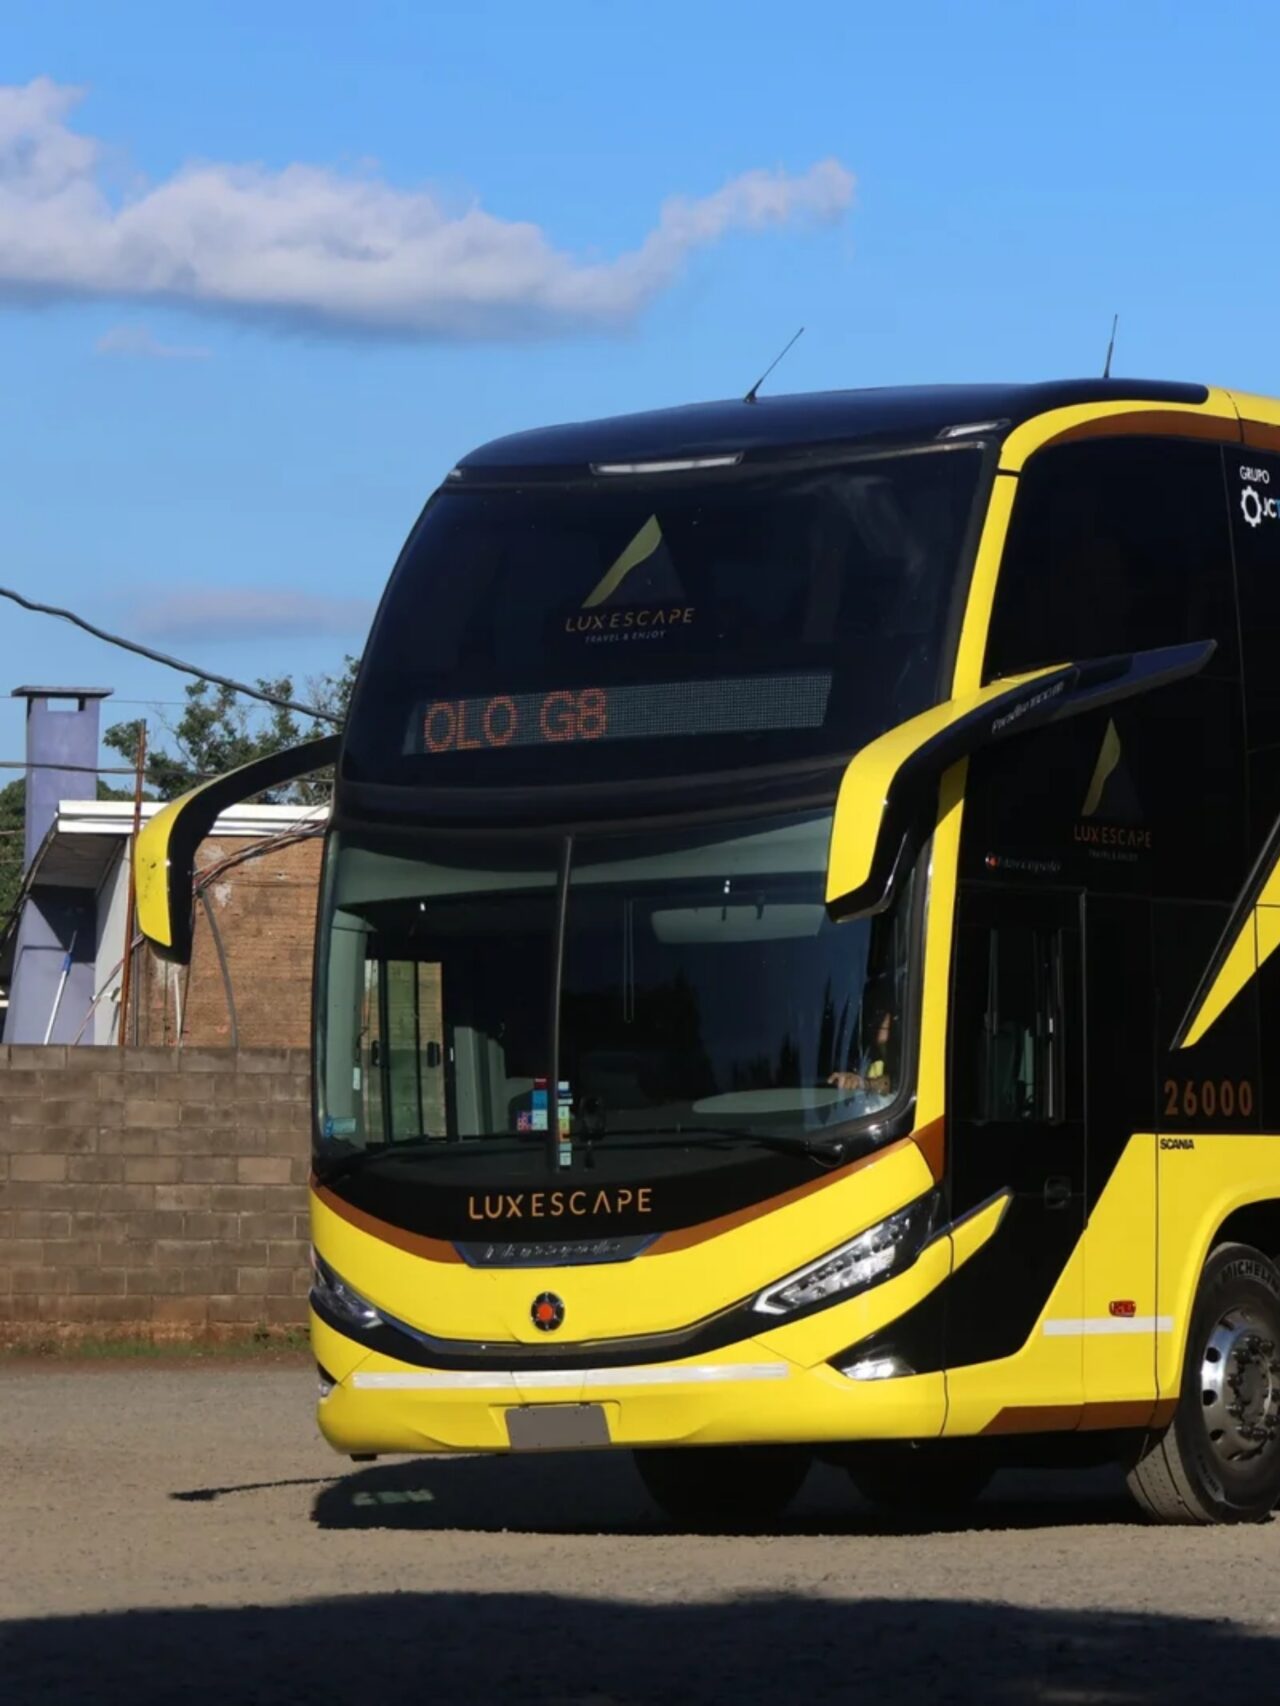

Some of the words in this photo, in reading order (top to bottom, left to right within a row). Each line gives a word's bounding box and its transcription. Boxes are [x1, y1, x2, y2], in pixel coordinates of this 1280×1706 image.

[1239, 465, 1270, 484] GRUPO
[565, 607, 696, 633] LUXESCAPE
[584, 632, 620, 644] TRAVEL
[424, 695, 518, 753] OLO
[540, 687, 608, 742] G8
[1073, 823, 1153, 848] LUXESCAPE
[1164, 1080, 1253, 1117] 26000
[1159, 1138, 1195, 1150] SCANIA
[468, 1188, 652, 1220] LUXESCAPE
